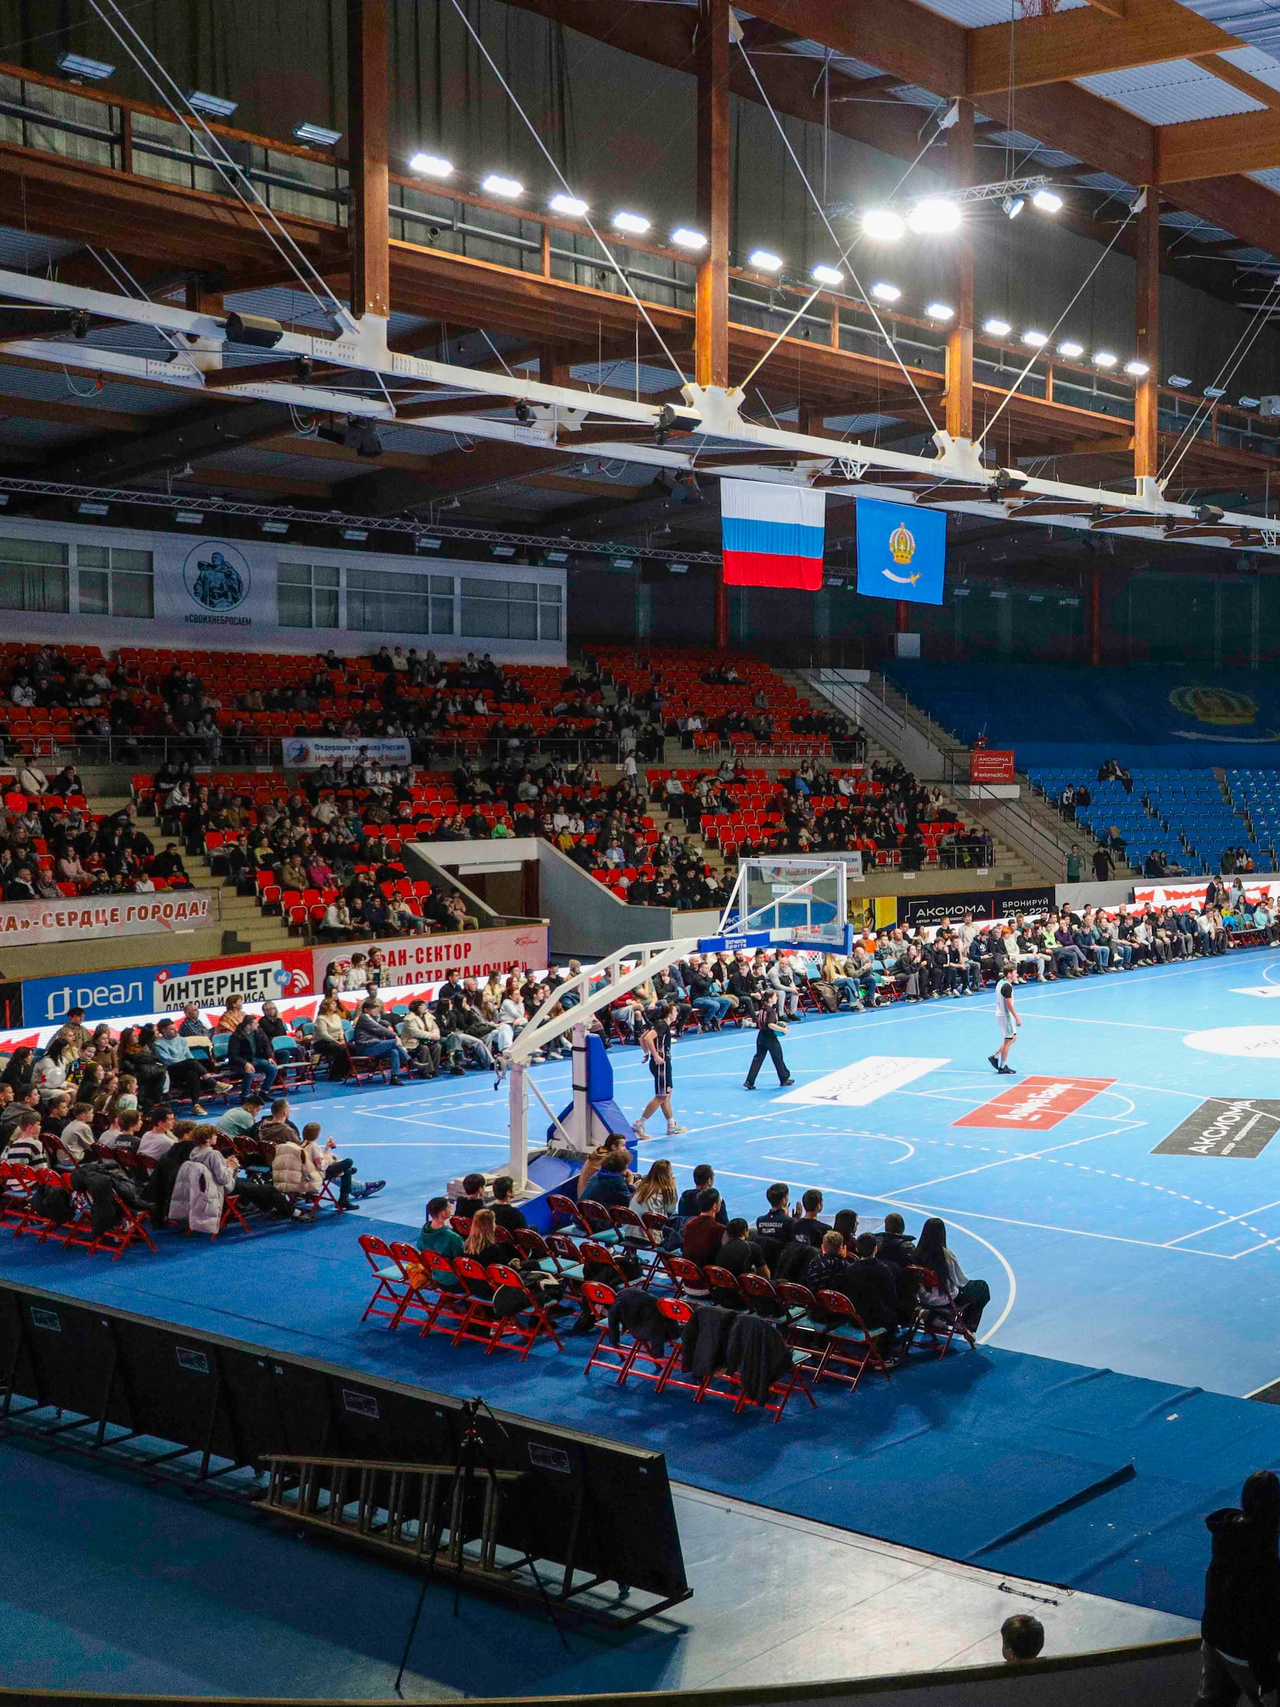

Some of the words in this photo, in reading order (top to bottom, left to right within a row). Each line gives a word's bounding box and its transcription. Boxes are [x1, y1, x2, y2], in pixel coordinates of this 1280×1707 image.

[1002, 897, 1049, 907] БРОНИРУЙ
[127, 901, 207, 921] ГОРОДА!
[916, 904, 986, 918] АКСИОМА
[162, 968, 273, 1002] ИНТЕРНЕТ
[194, 998, 215, 1008] ОМА
[1187, 1100, 1256, 1154] АКСИОМА
